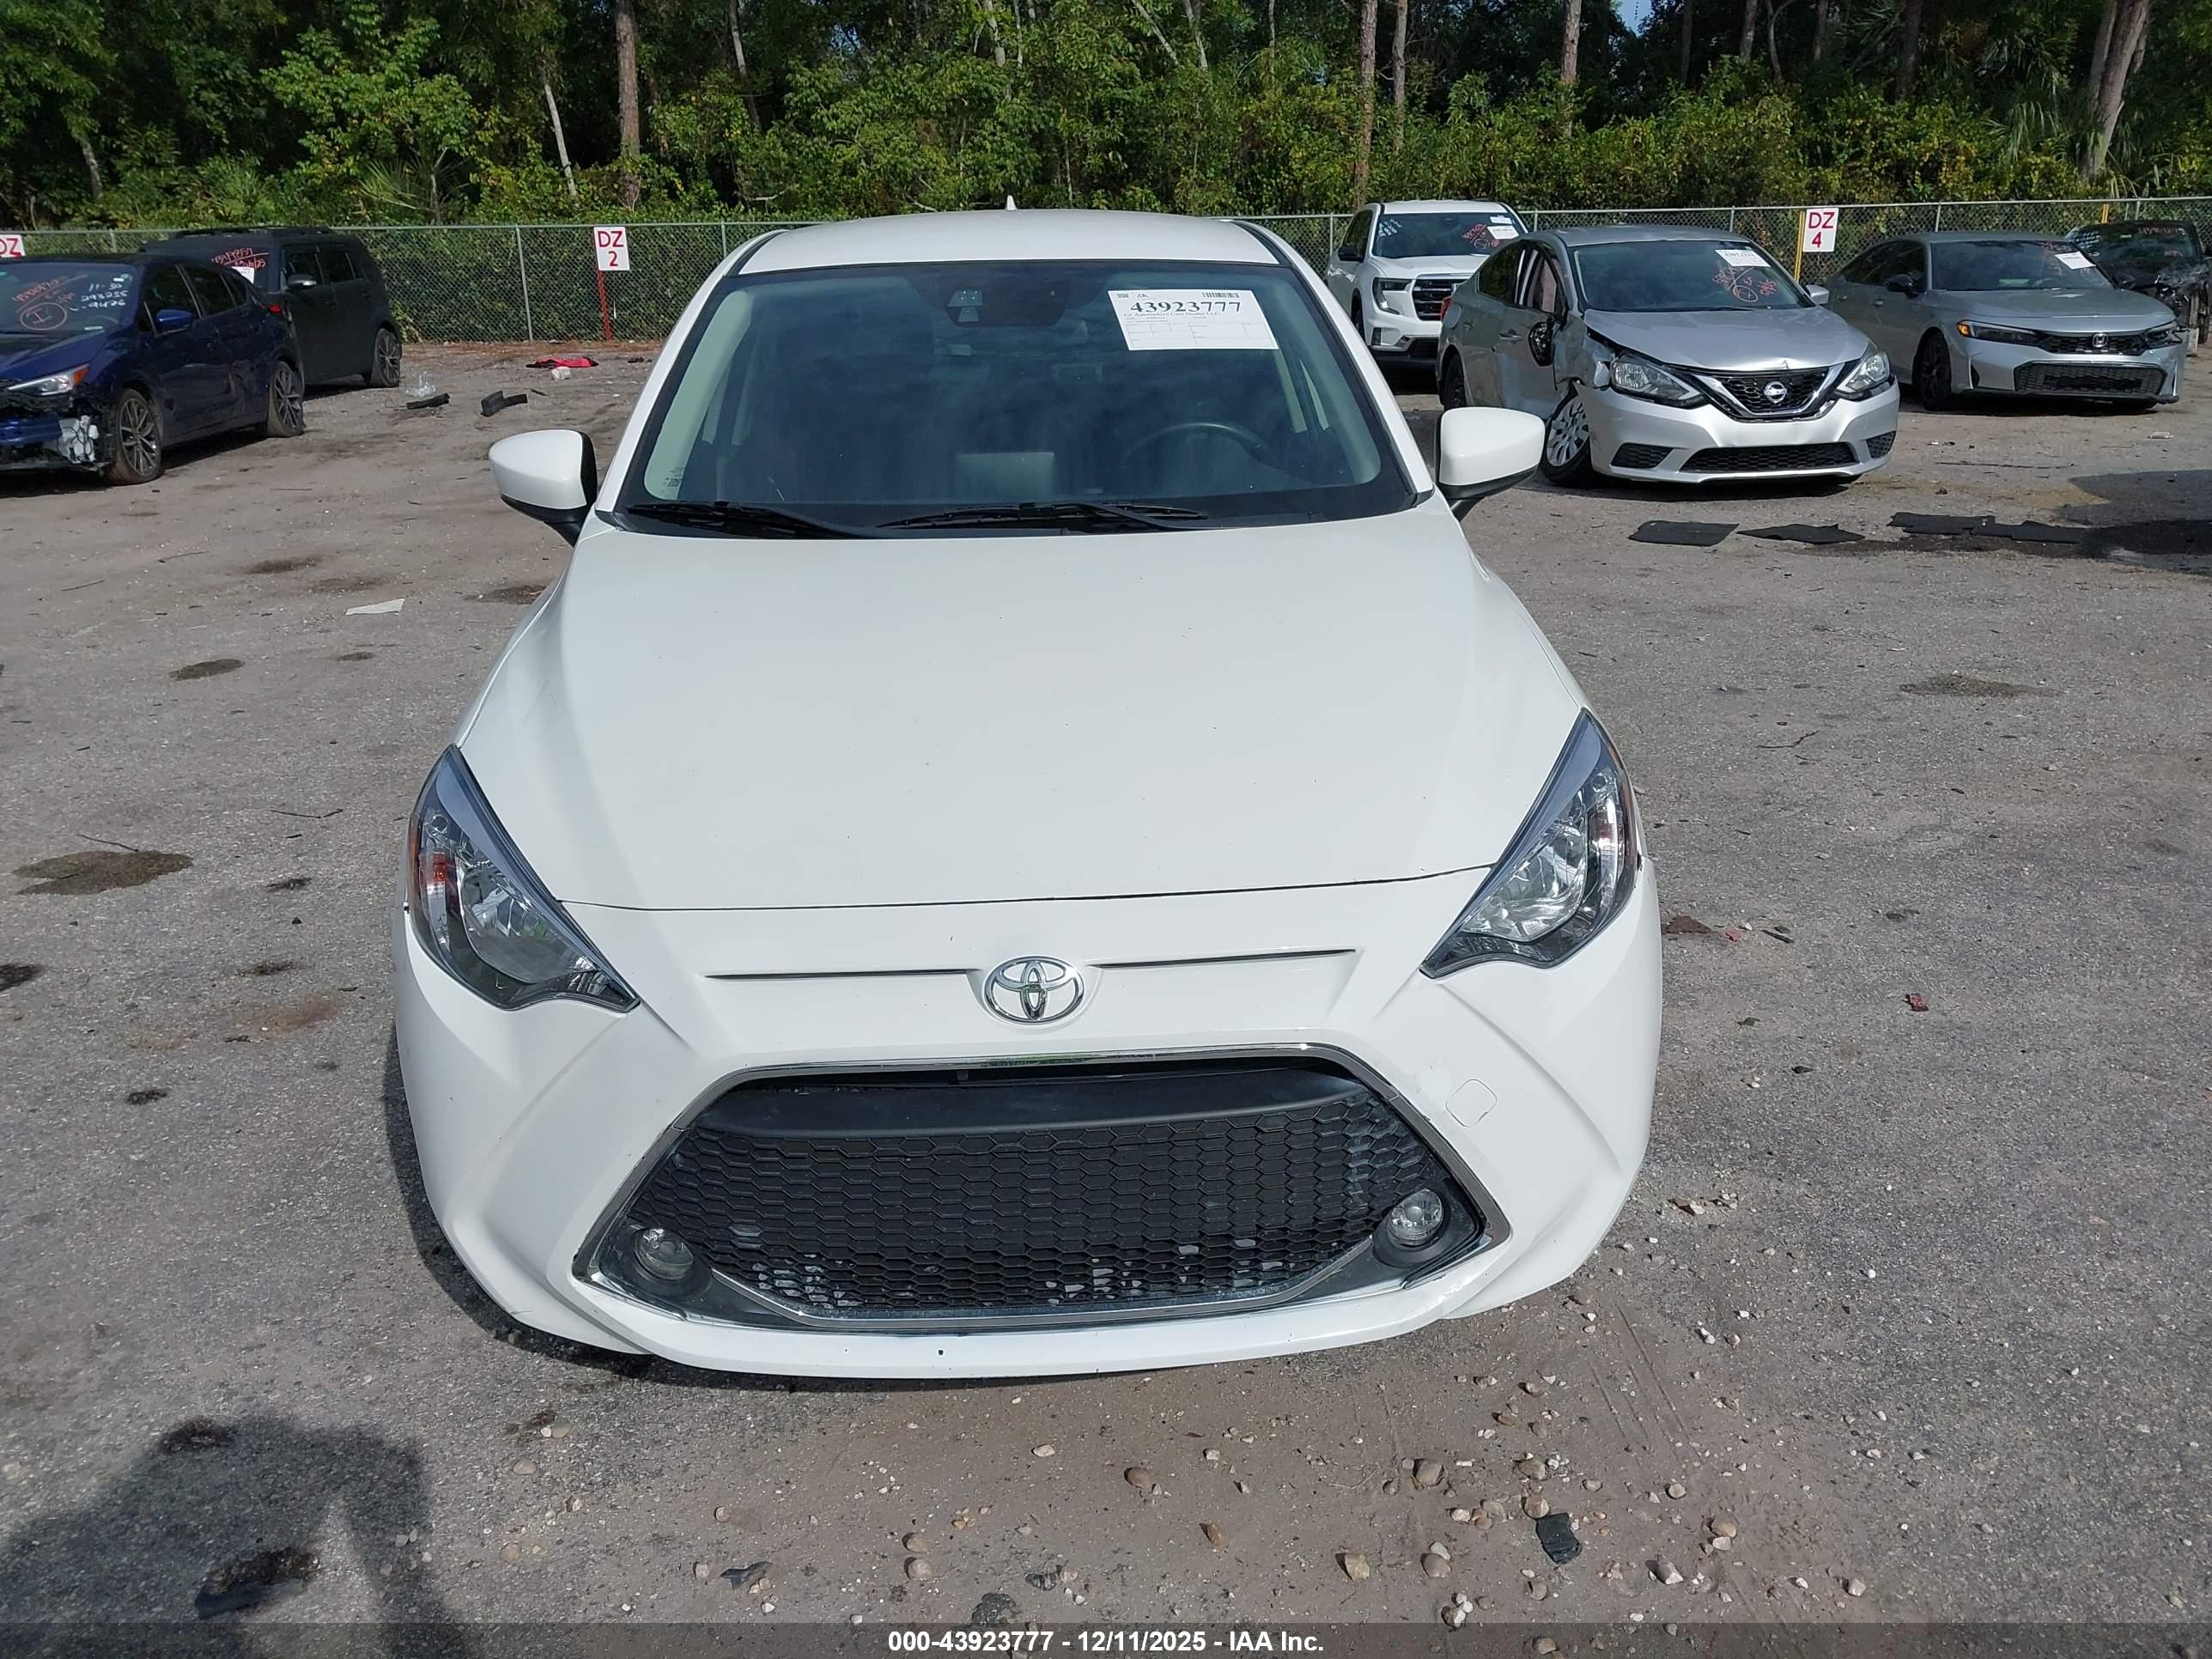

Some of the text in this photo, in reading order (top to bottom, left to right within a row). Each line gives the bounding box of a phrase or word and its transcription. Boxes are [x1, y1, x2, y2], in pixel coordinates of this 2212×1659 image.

[1808, 212, 1835, 228] DZ
[598, 230, 624, 247] DZ
[1812, 231, 1822, 248] 4
[608, 251, 618, 267] 2
[1130, 301, 1241, 313] 43923777
